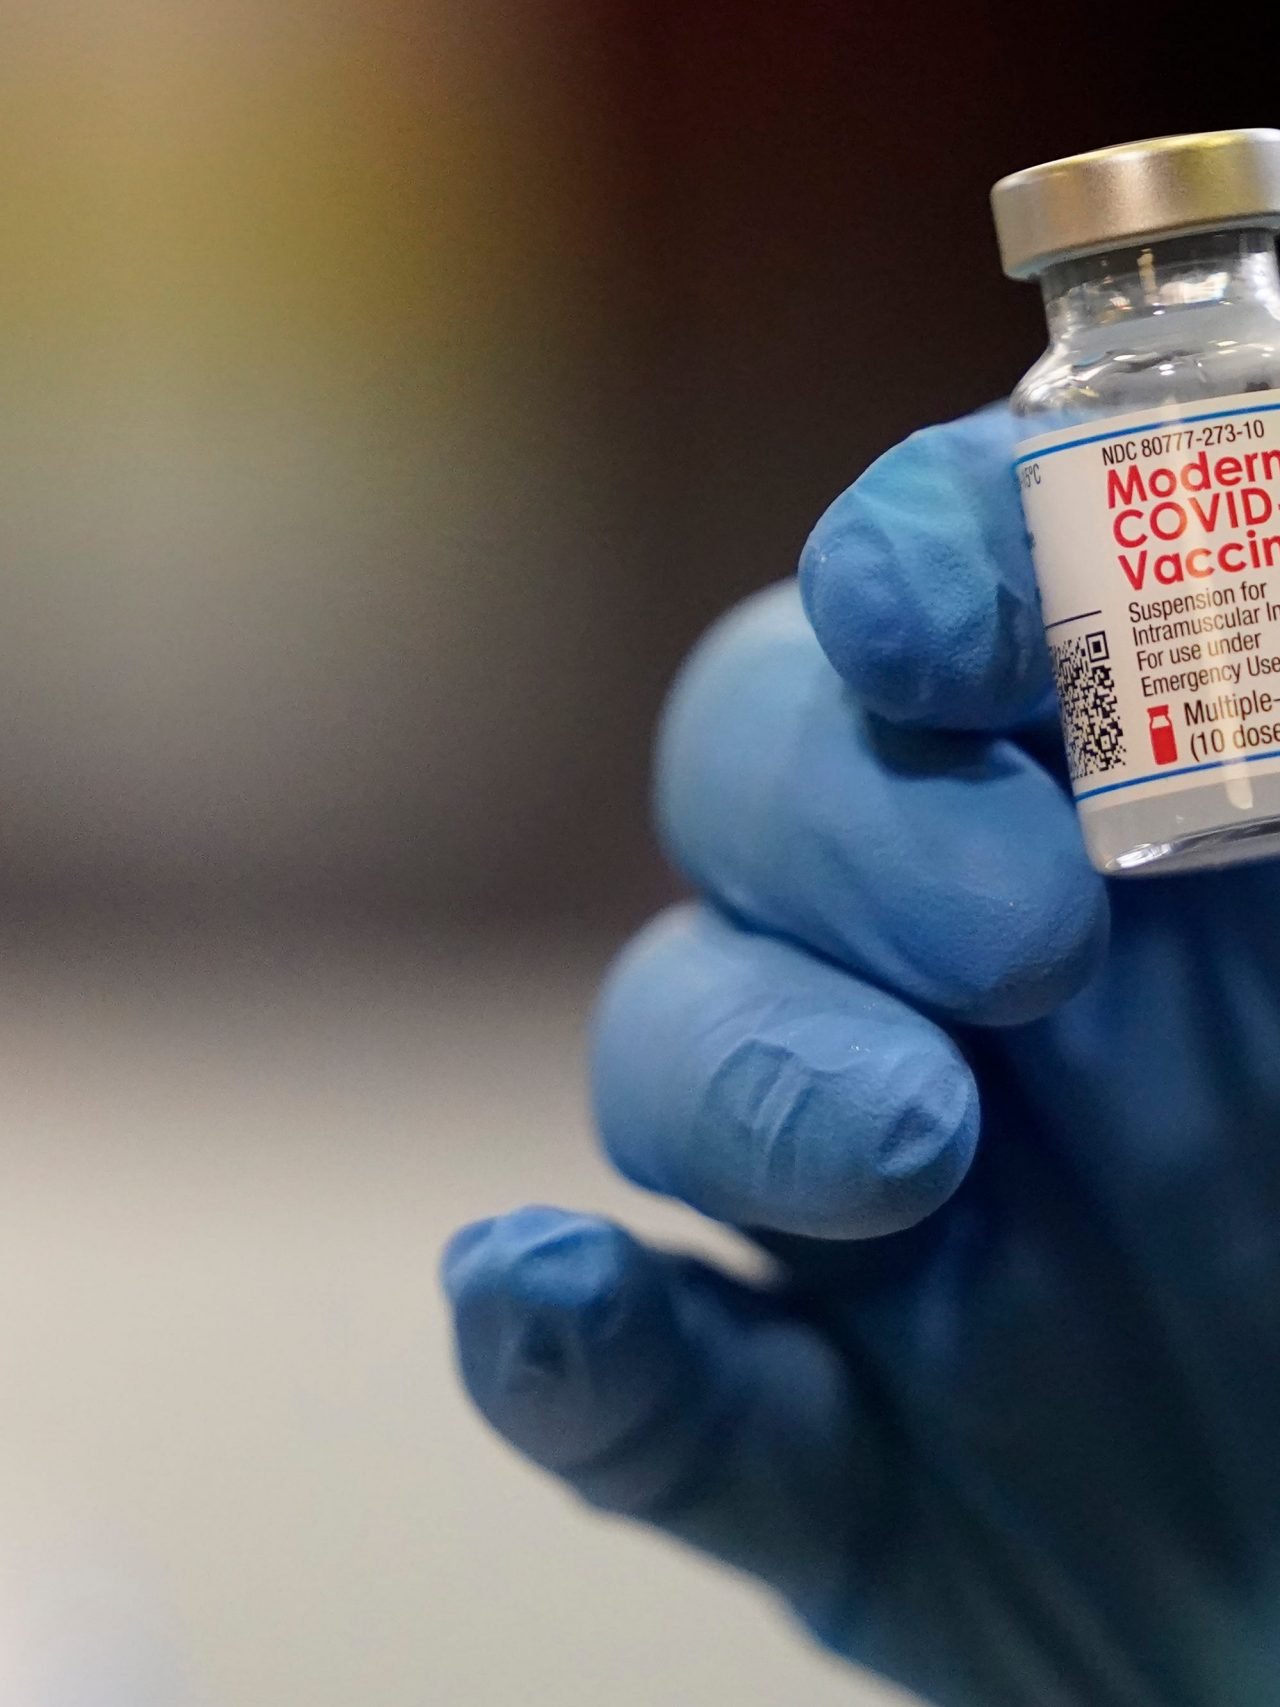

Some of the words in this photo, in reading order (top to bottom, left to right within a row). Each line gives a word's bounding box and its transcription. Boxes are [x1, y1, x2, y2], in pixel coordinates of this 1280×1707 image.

[1103, 441, 1137, 466] NDC
[1141, 419, 1265, 458] 80777-273-10
[1128, 586, 1236, 624] Suspension
[1240, 581, 1267, 601] for
[1132, 605, 1260, 646] Intramuscular
[1136, 650, 1163, 671] For
[1170, 645, 1201, 666] use
[1207, 630, 1262, 658] under
[1141, 662, 1241, 697] Emergency
[1190, 730, 1225, 762] (10
